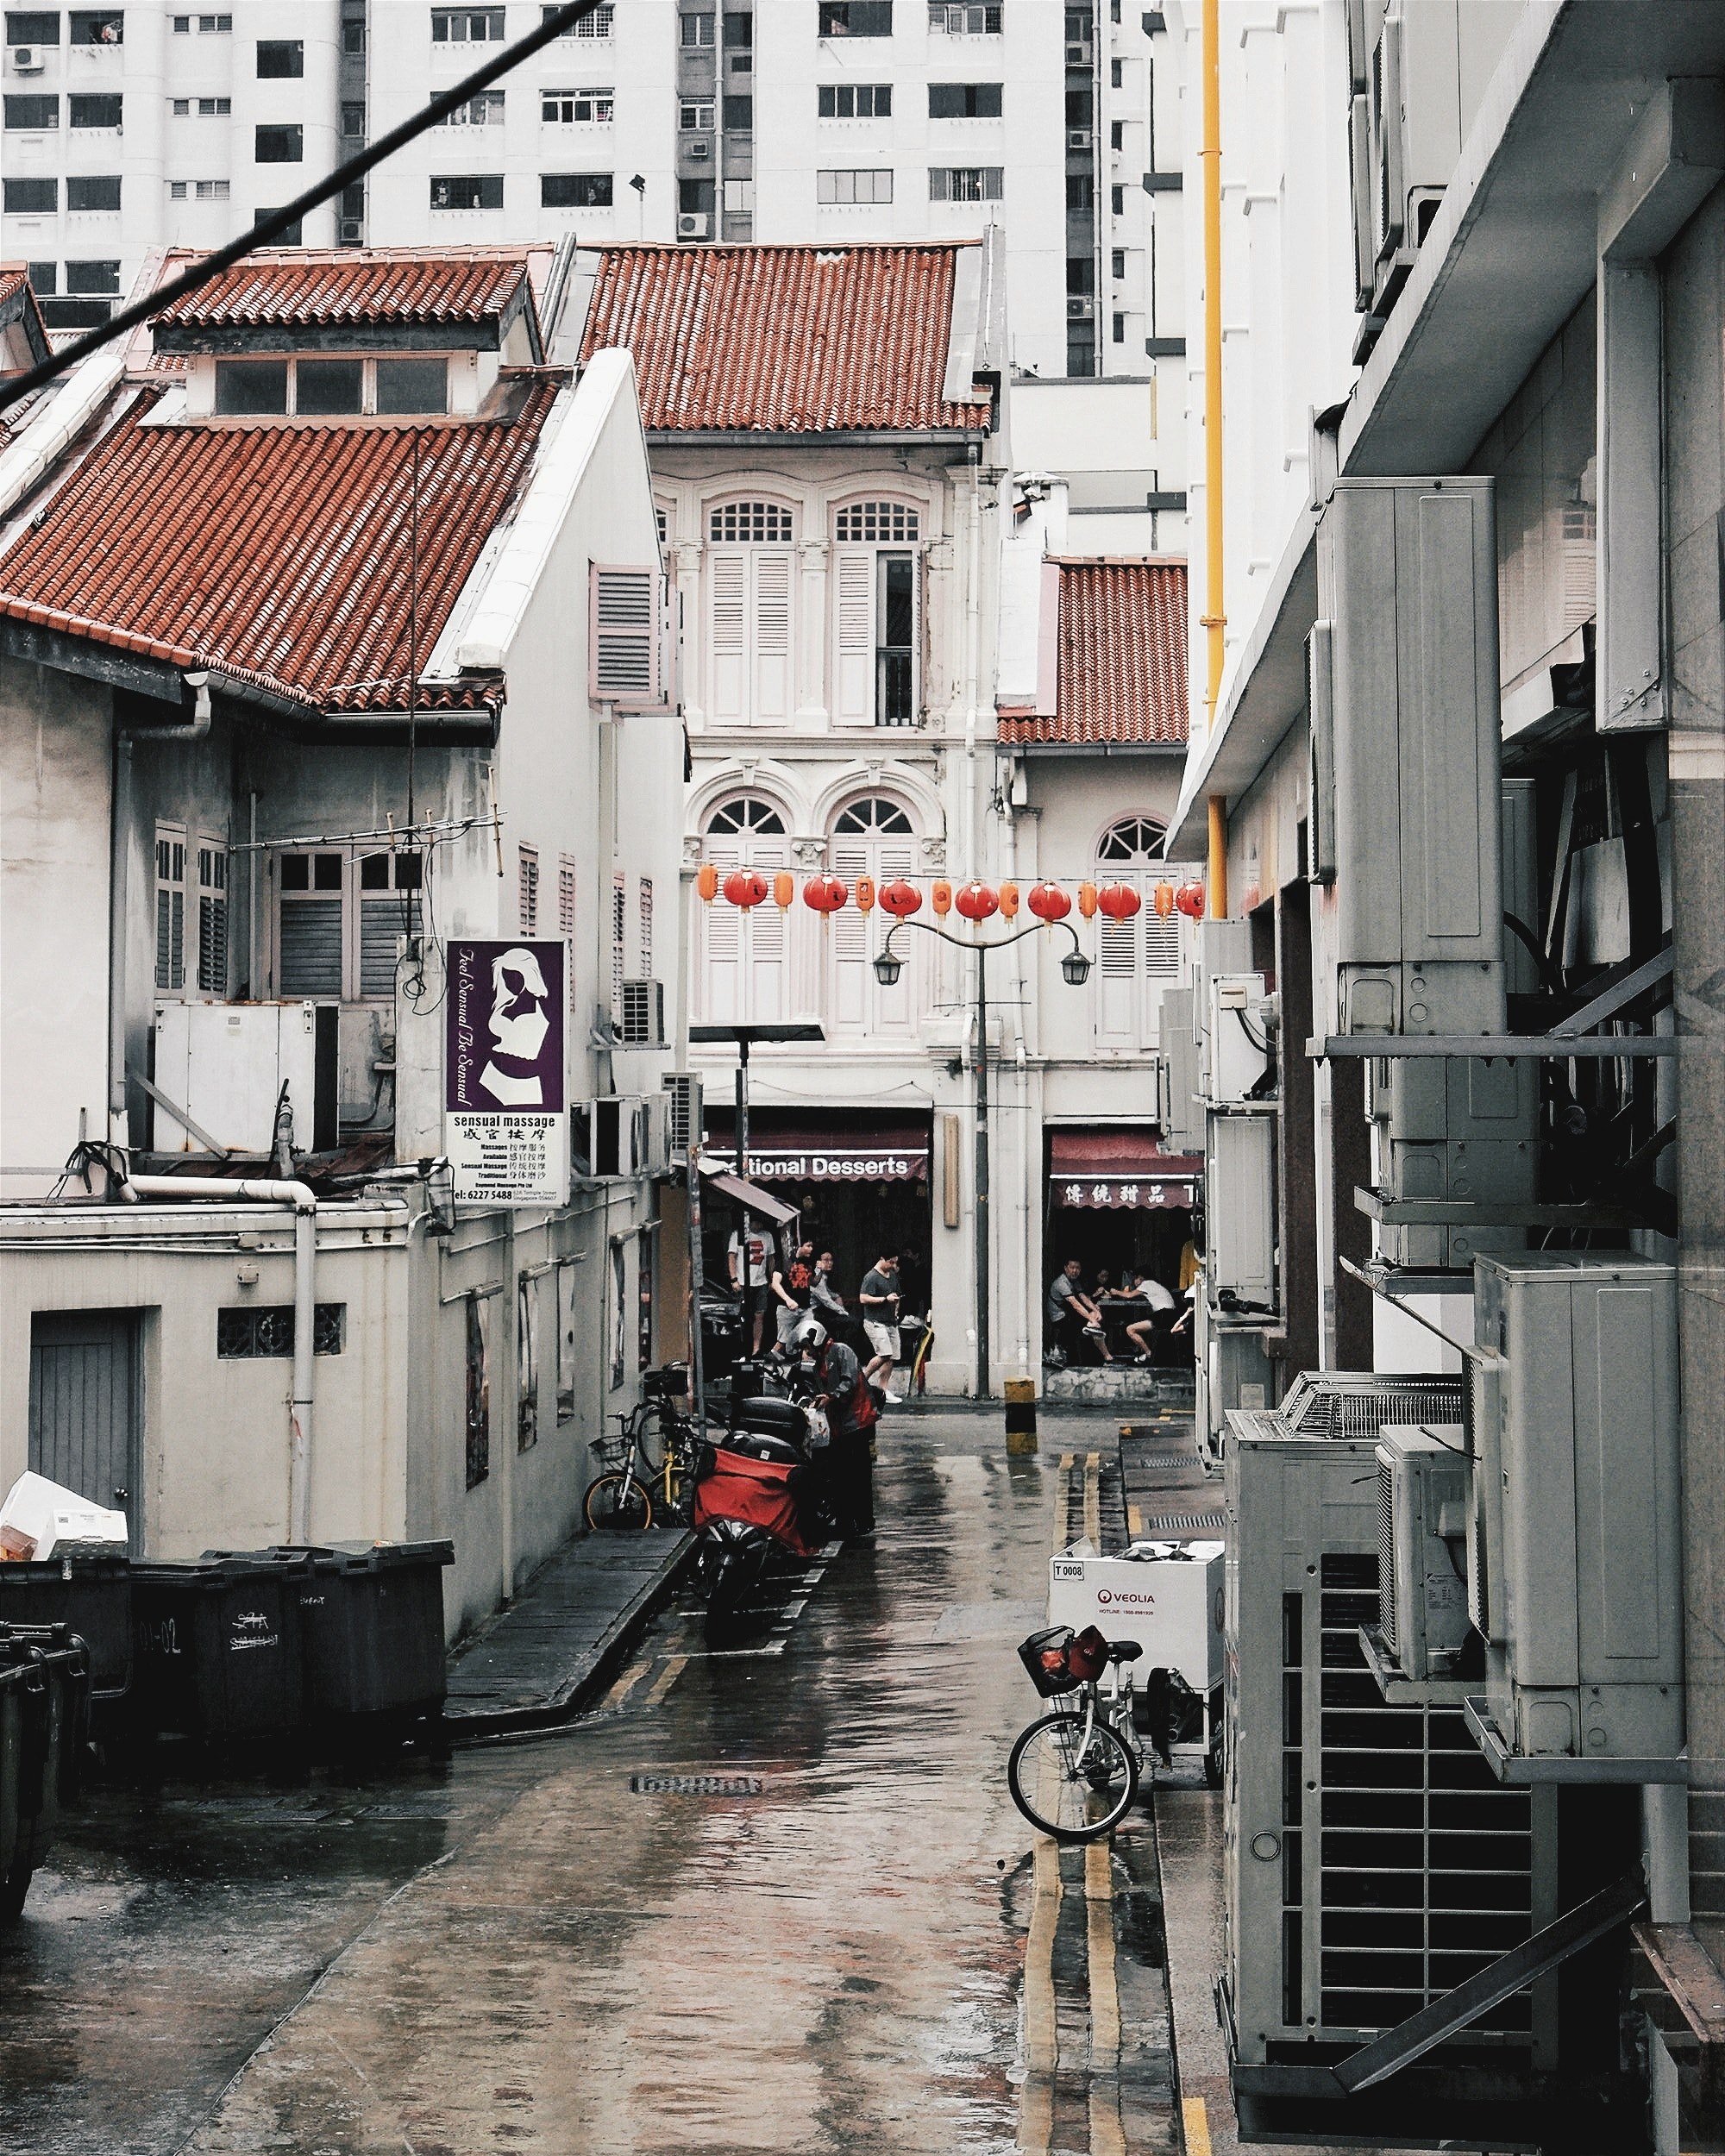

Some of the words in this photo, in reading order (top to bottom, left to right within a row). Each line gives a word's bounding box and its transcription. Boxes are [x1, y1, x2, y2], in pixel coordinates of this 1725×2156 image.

[459, 949, 474, 980] Feel
[458, 980, 474, 1031] Sensual
[458, 1030, 474, 1052] Be
[457, 1054, 474, 1107] Sensual
[454, 1115, 500, 1127] sensual
[503, 1117, 555, 1128] massage
[812, 1157, 908, 1175] Desserts
[454, 1189, 467, 1200] el:
[467, 1190, 489, 1200] 6227
[491, 1190, 512, 1200] 5488
[1055, 1565, 1062, 1576] T
[1113, 1593, 1155, 1603] VEOLIA
